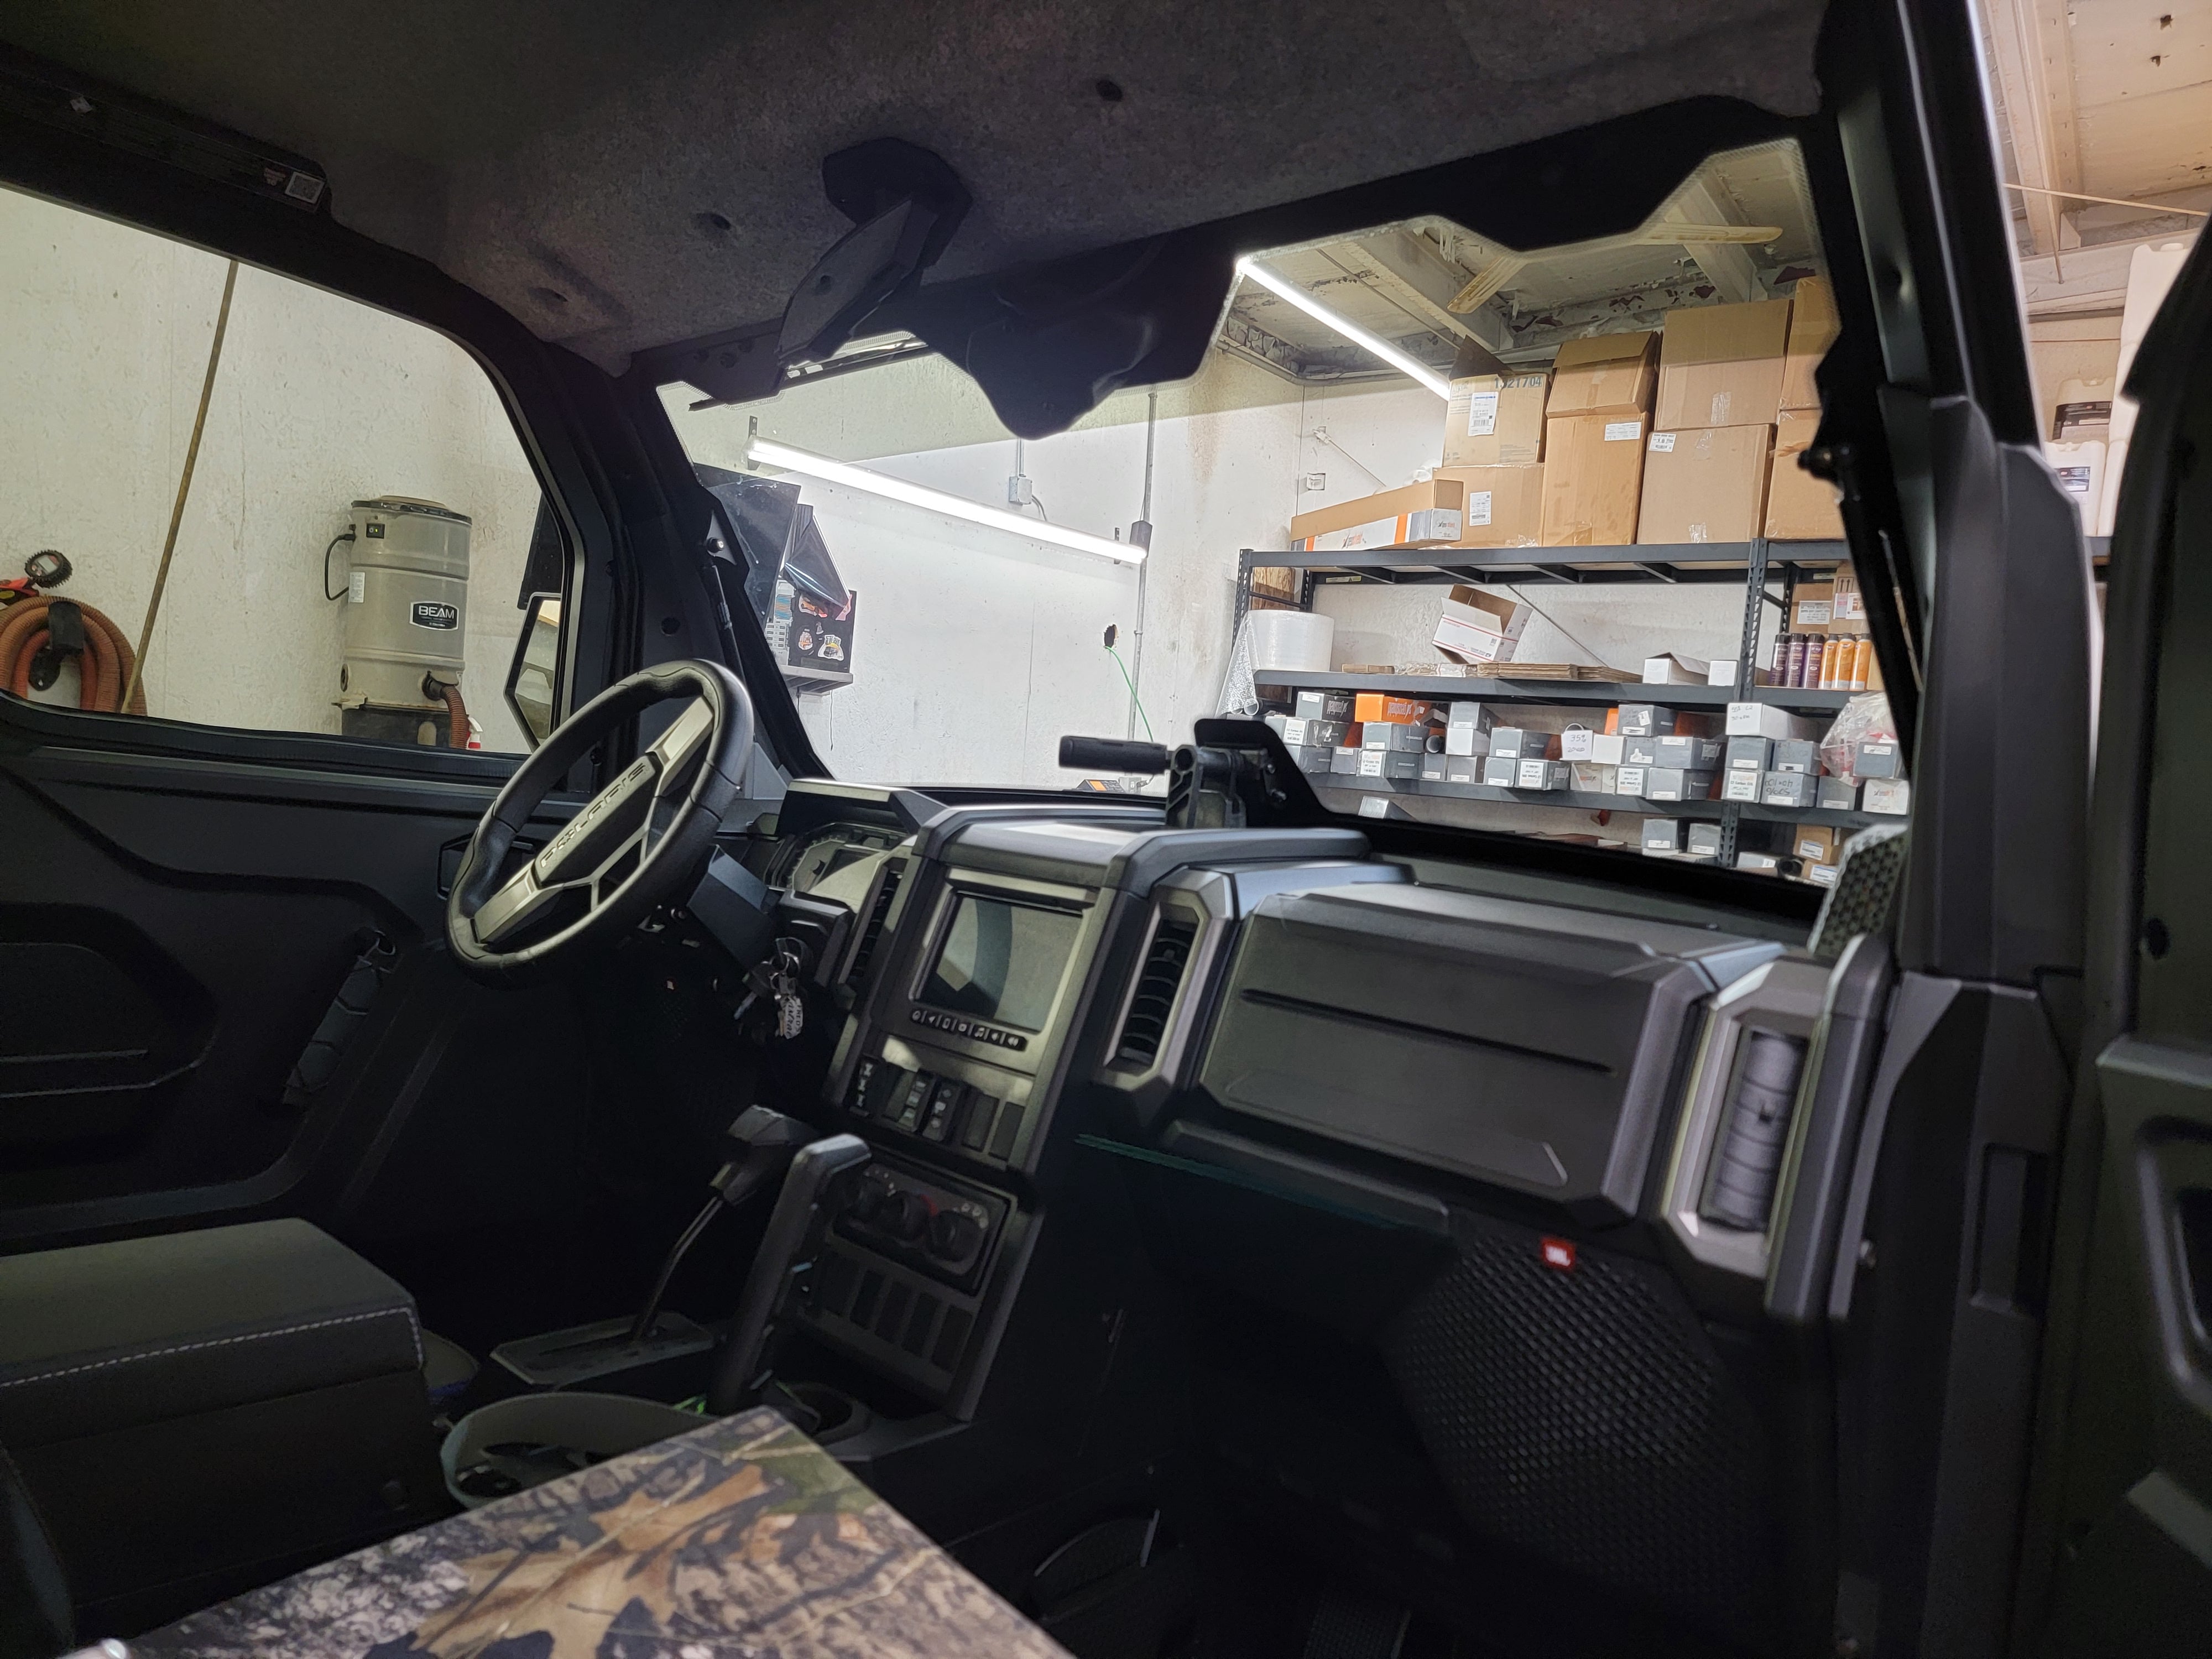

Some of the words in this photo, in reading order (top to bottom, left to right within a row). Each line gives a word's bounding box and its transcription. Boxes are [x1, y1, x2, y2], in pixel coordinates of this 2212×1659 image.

[419, 606, 454, 619] BEAM
[1571, 734, 1587, 743] 35%
[540, 763, 646, 868] POLARIS
